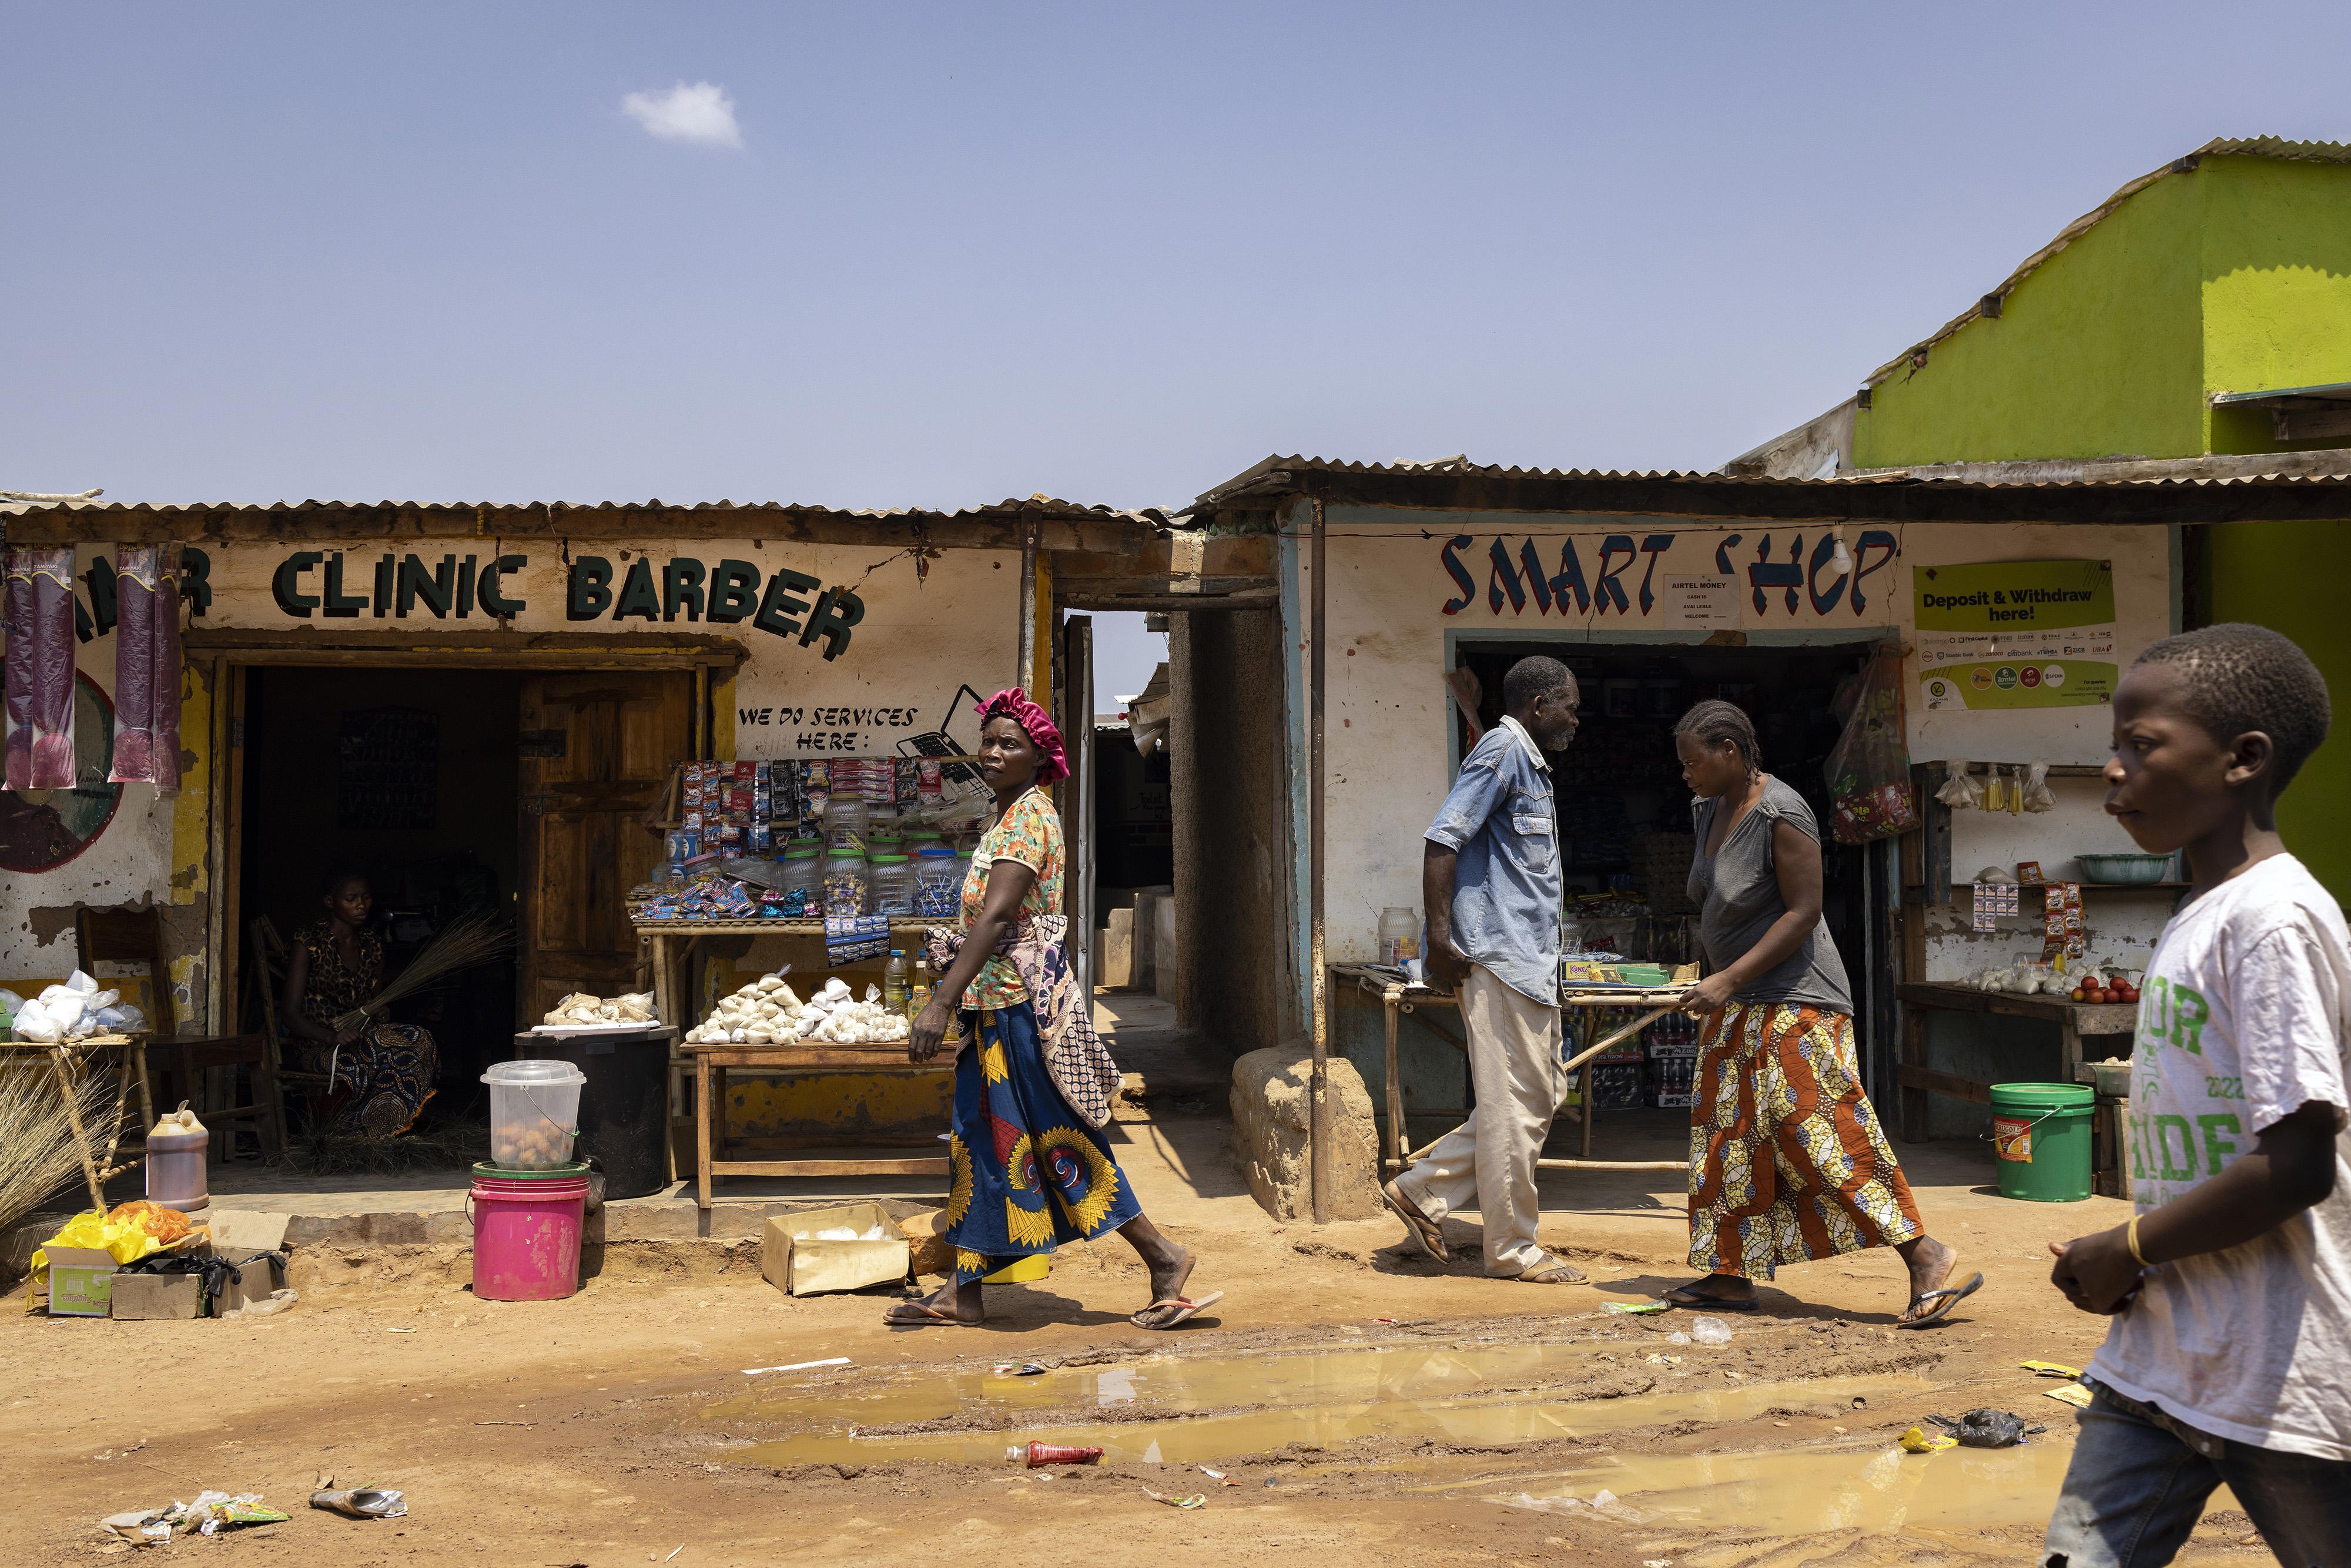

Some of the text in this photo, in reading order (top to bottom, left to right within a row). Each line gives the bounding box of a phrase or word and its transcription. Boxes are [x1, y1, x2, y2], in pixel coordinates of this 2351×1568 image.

[1441, 534, 1675, 616] SMART
[272, 551, 527, 619] CLINIC
[566, 555, 866, 662] BARBER
[1923, 588, 2092, 610] Deposit & Withdraw
[1989, 606, 2034, 621] here!
[739, 707, 920, 728] WE DO SERVICES
[1570, 964, 1588, 976] KUNG
[2142, 976, 2209, 1056] OR
[1673, 1046, 1697, 1055] MZURI
